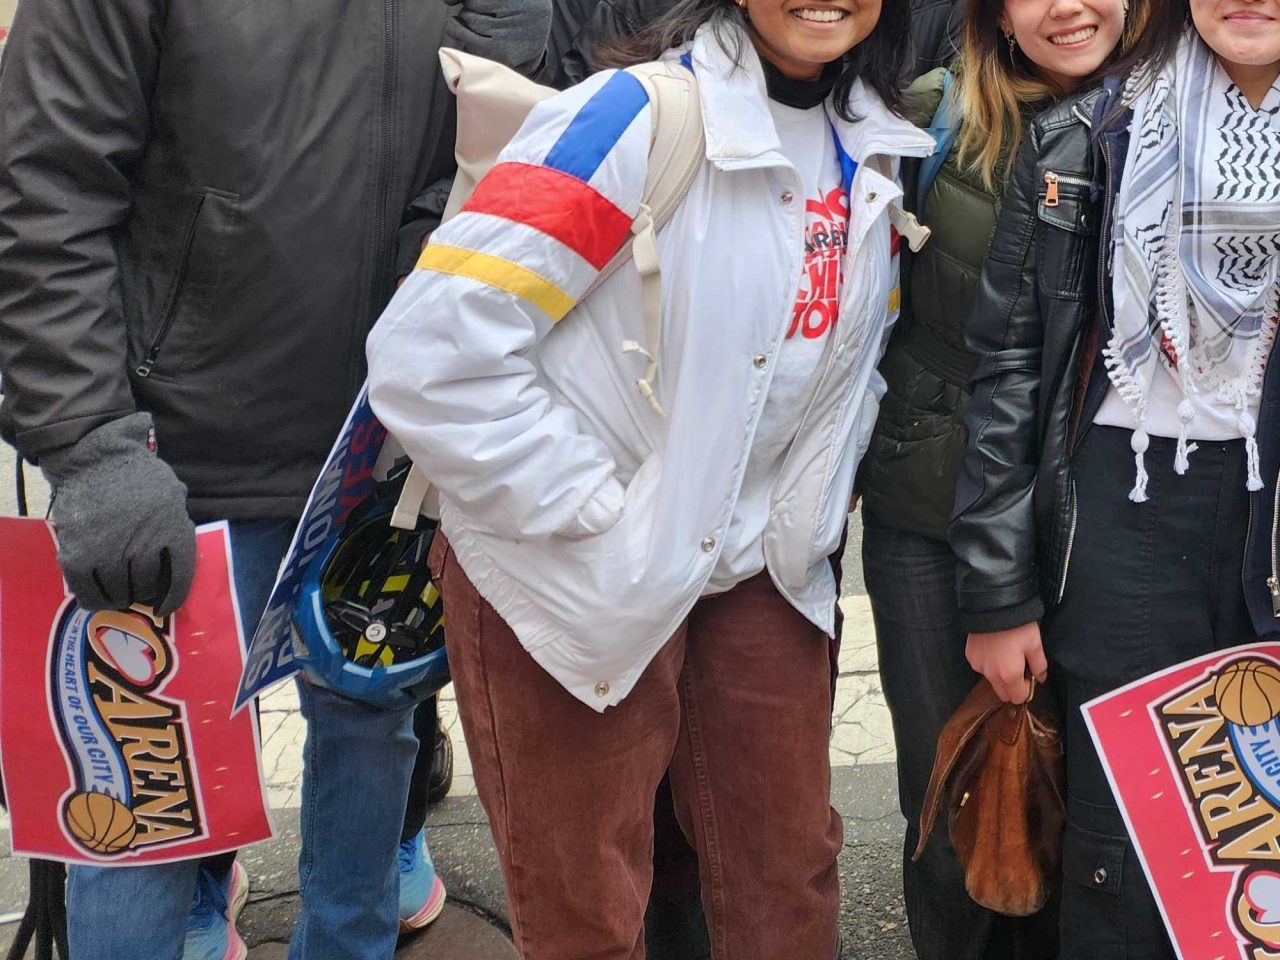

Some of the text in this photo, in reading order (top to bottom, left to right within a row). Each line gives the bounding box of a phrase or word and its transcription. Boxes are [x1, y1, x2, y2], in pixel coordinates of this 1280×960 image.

[64, 624, 115, 784] IN THE HEART OF OUR CITY
[88, 660, 197, 848] ARENA
